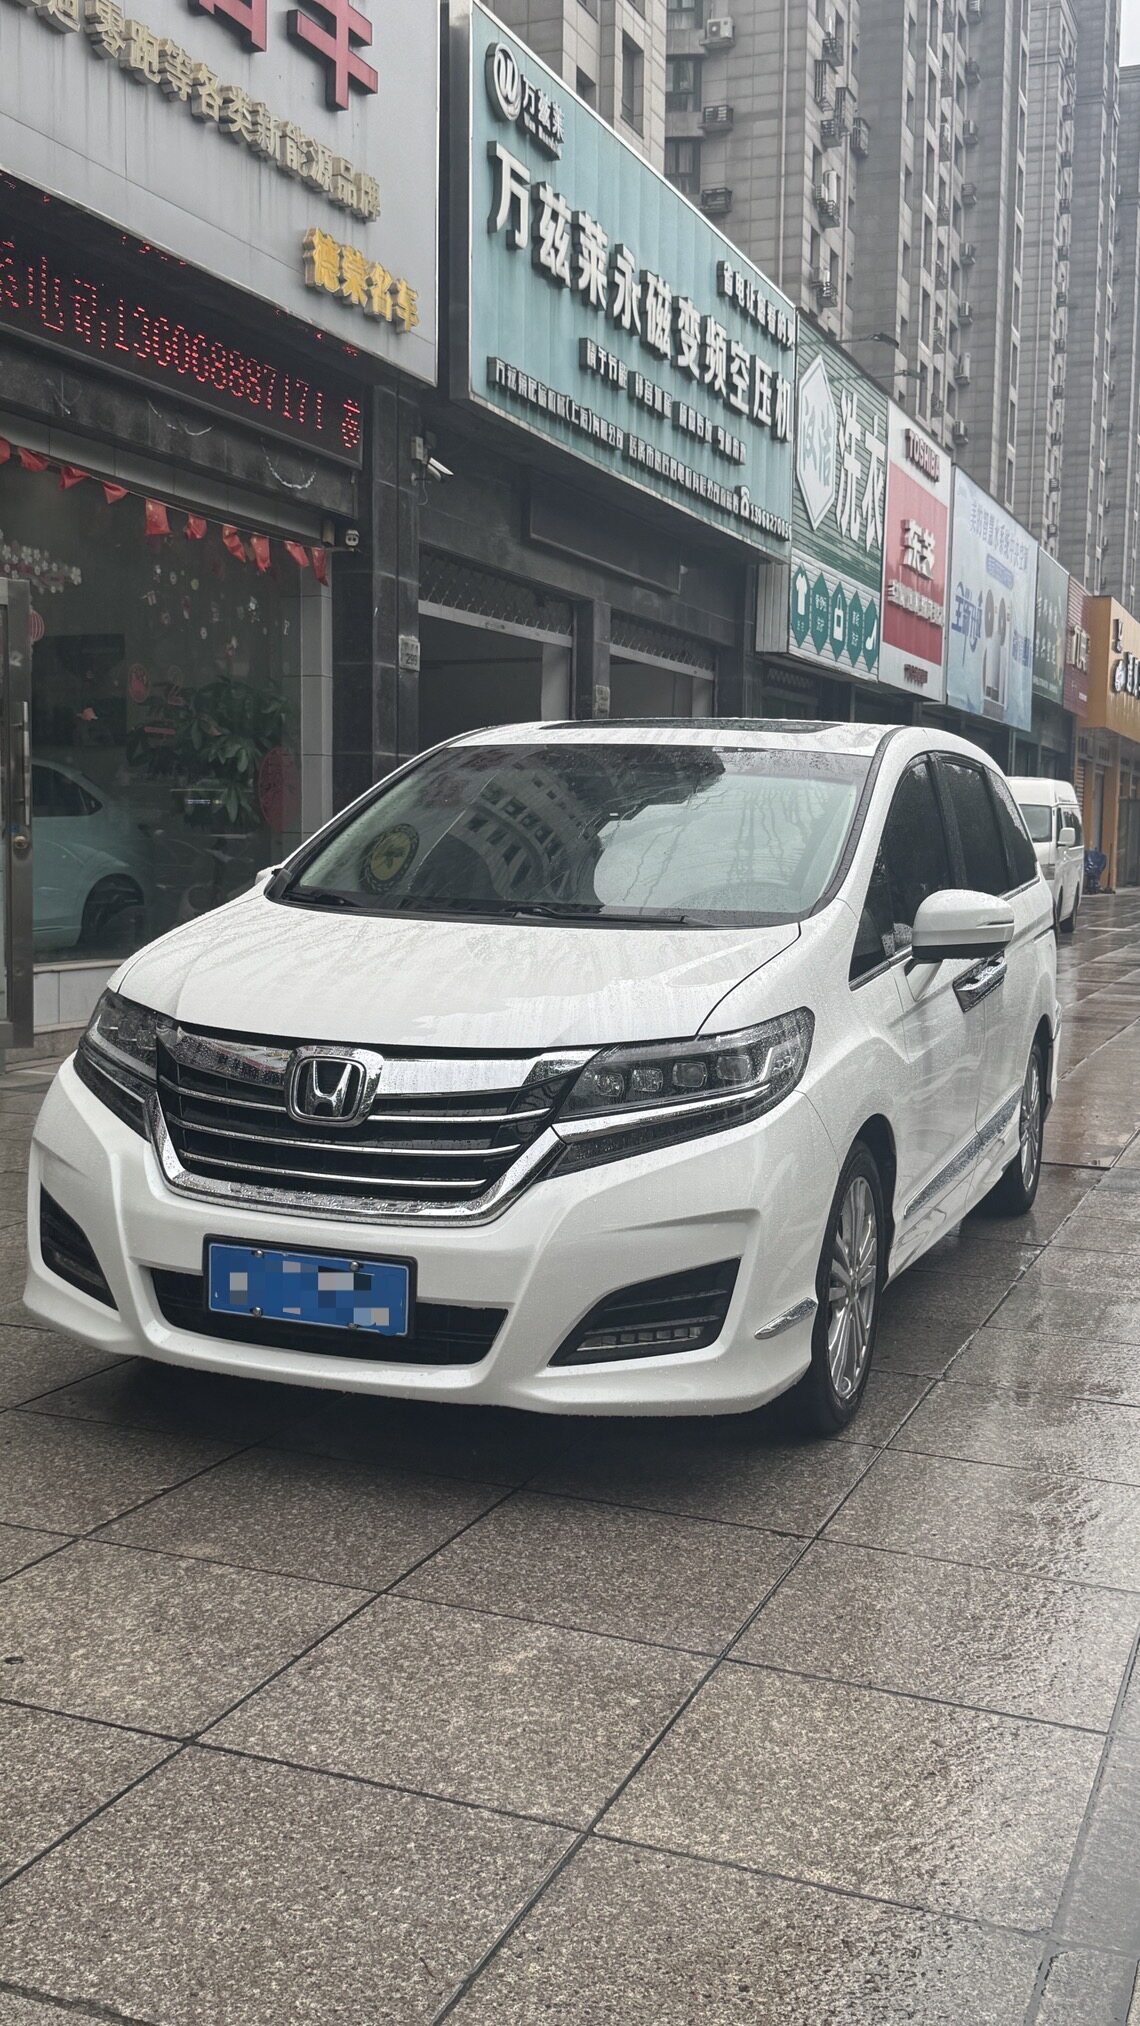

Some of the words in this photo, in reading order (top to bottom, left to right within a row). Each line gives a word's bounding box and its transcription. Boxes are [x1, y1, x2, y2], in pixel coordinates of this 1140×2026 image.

[521, 74, 565, 141] 万兹莱
[490, 141, 792, 442] 万兹莱永磁变频空压机
[836, 388, 887, 553] 洗衣
[907, 429, 940, 481] TOSHIBA
